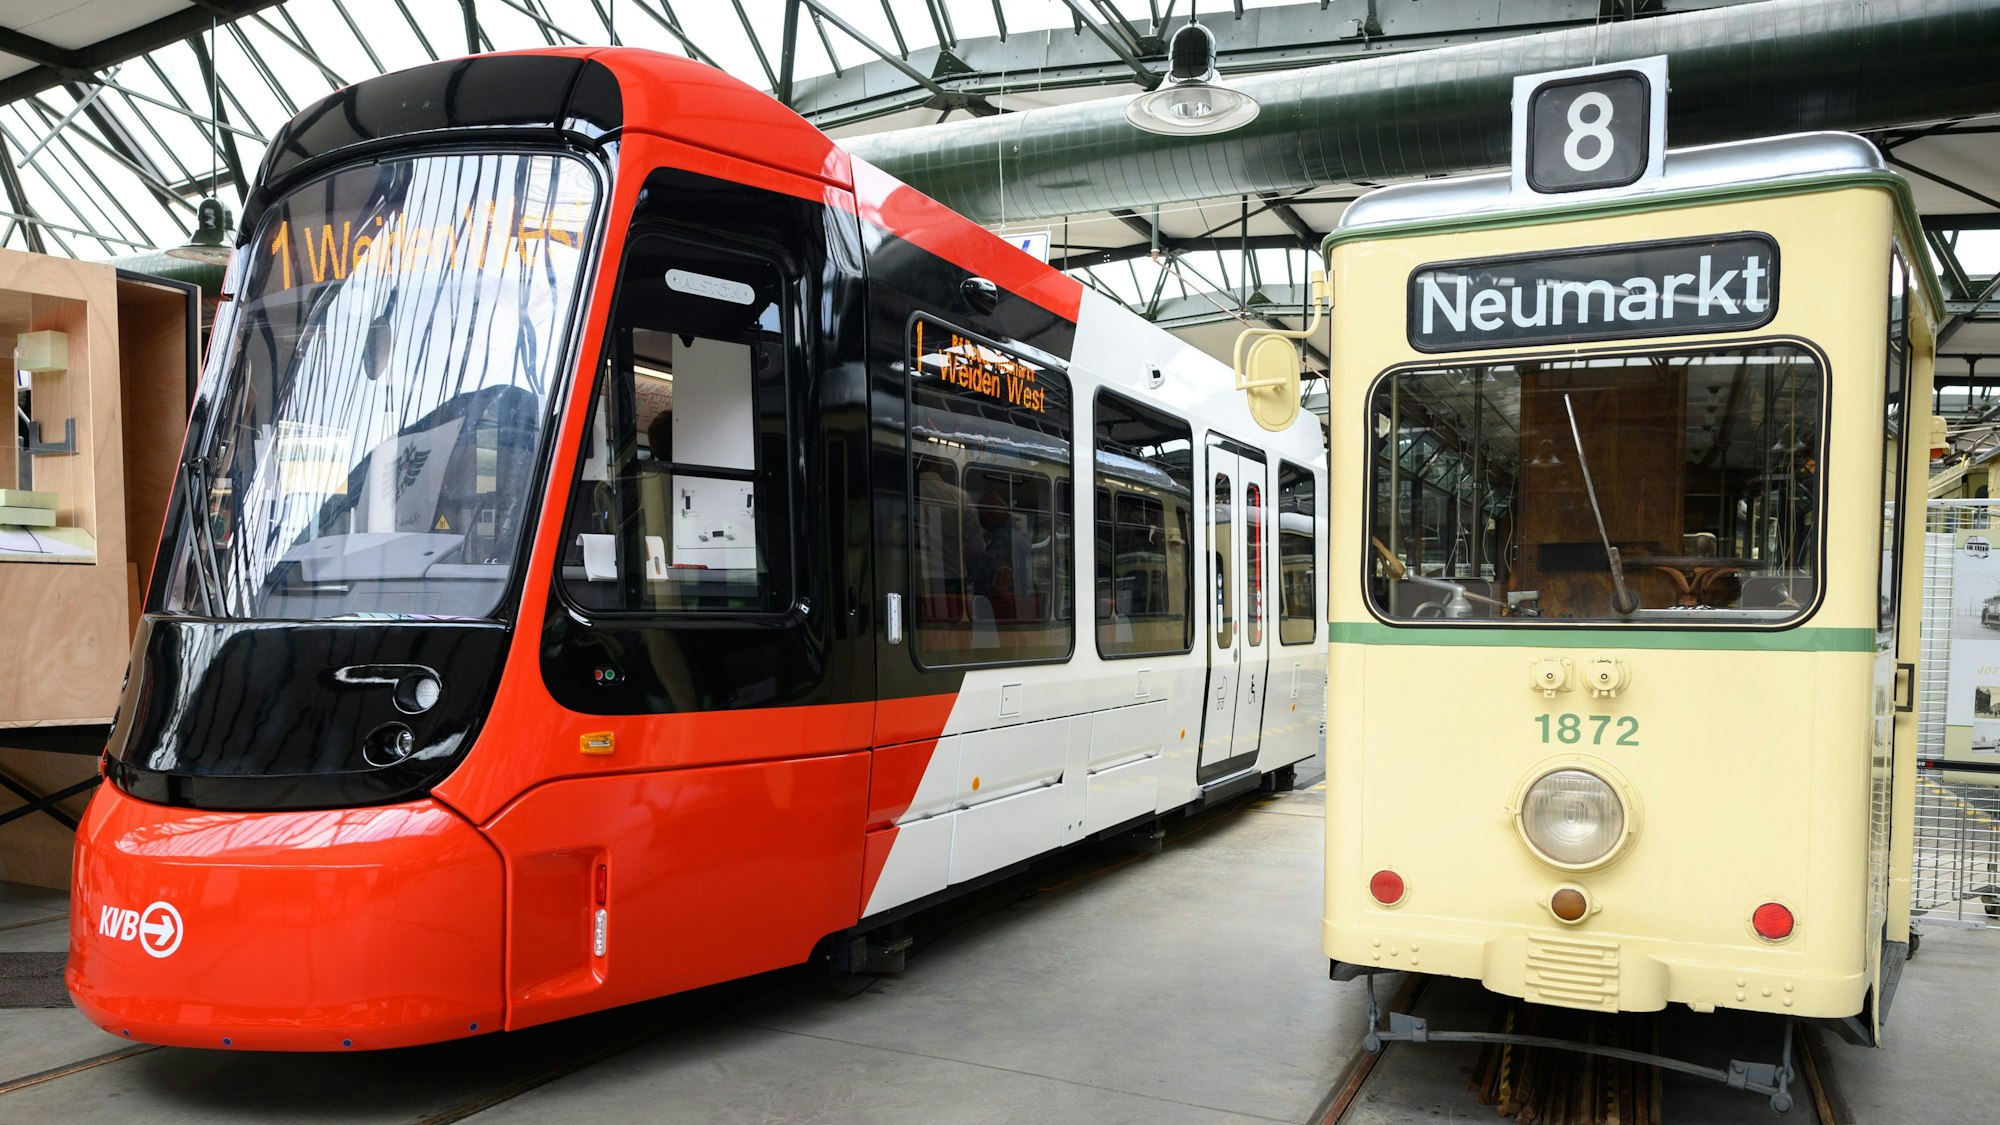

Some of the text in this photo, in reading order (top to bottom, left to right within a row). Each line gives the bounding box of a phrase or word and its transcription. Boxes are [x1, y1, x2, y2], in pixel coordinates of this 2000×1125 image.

[1563, 91, 1614, 172] 8
[271, 219, 291, 291] 1
[304, 210, 457, 283] Weiden
[1422, 254, 1766, 335] Neumarkt
[939, 348, 1001, 399] Weiden
[1007, 373, 1046, 413] West
[1535, 713, 1640, 747] 1872
[99, 904, 141, 942] KVB
